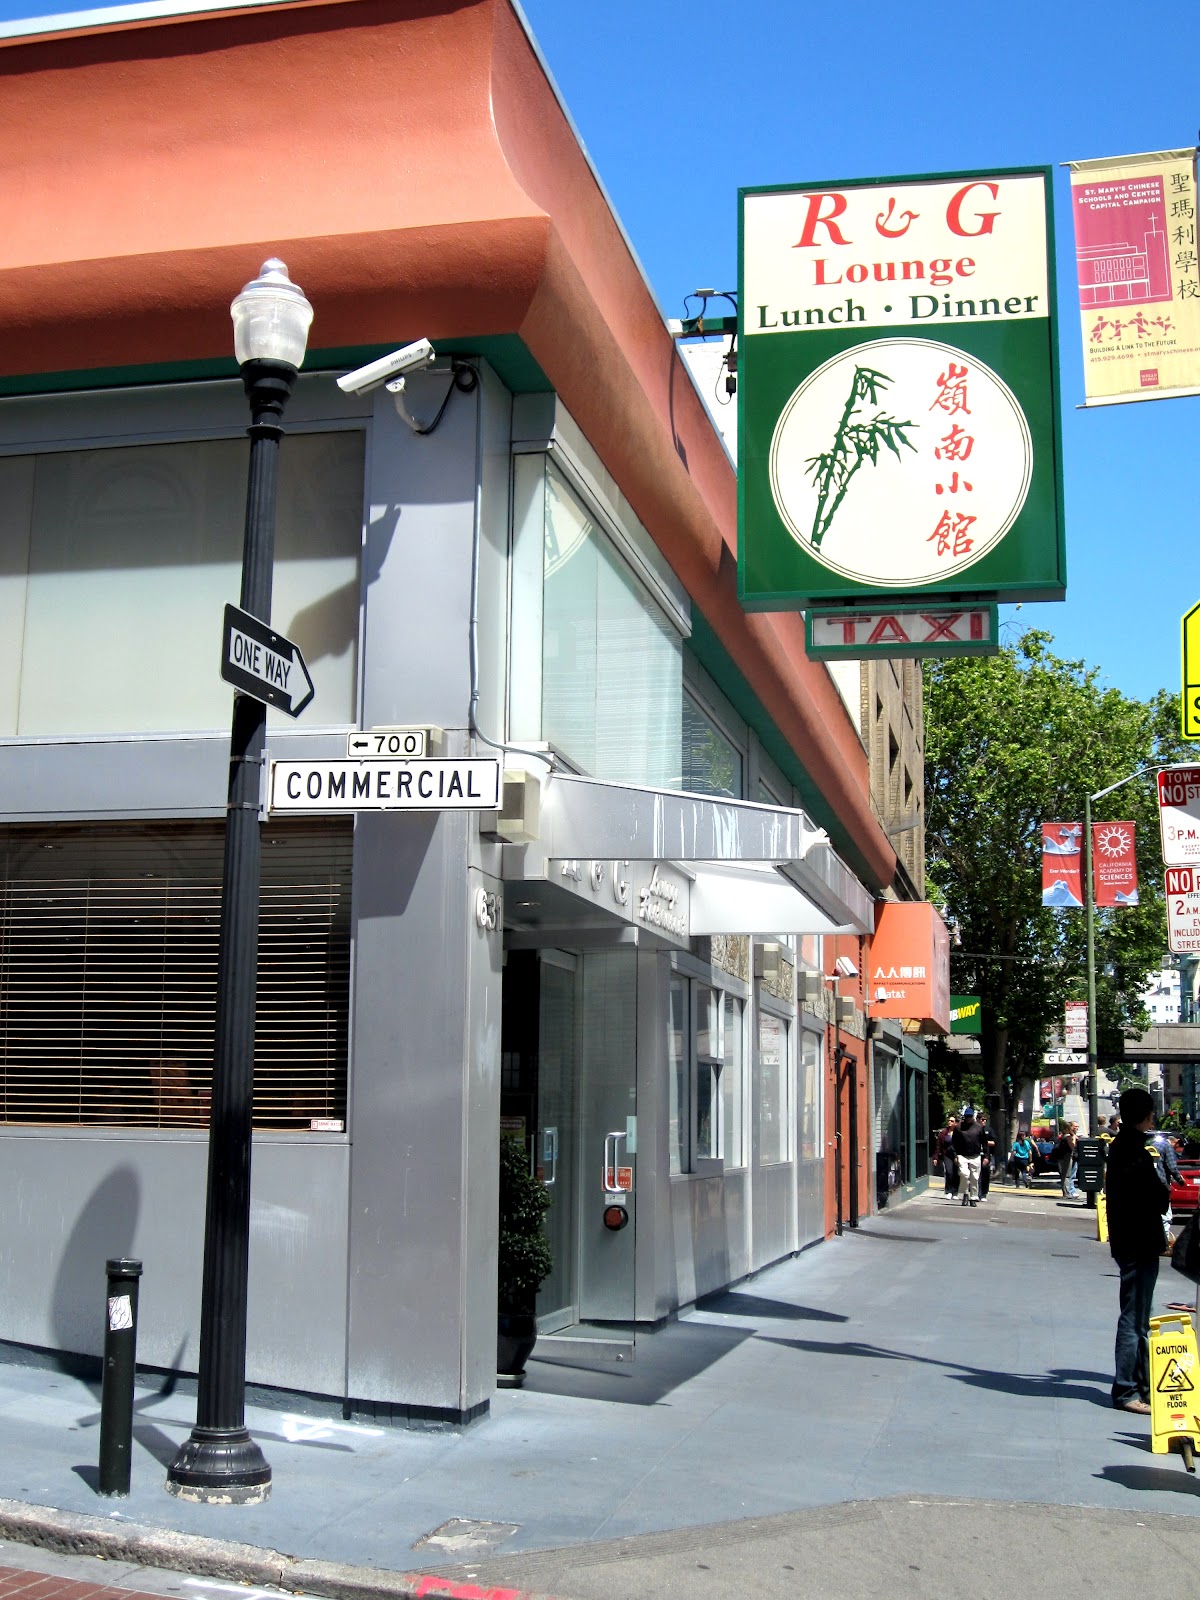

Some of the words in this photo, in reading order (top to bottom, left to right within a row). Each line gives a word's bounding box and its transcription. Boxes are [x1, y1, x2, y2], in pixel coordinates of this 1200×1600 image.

[1078, 195, 1112, 204] SCHOOLS
[1131, 190, 1160, 198] CENTER
[1098, 186, 1126, 194] MARY'S
[1128, 182, 1160, 190] CHINESE
[1090, 202, 1121, 210] CAPITAL
[1123, 197, 1161, 206] CAMPAIGN
[791, 193, 853, 248] R
[875, 197, 920, 238] &
[946, 182, 1002, 237] G
[1170, 173, 1200, 300] 聖瑪利學校
[811, 257, 976, 286] Lounge
[757, 298, 867, 328] Lunch
[909, 293, 1039, 319] Dinner
[1089, 346, 1115, 354] BUILDING
[1156, 339, 1177, 347] FUTURE
[390, 353, 412, 366] PHILIPS
[926, 363, 977, 556] 嶺南小館
[827, 612, 983, 645] TAXI
[234, 634, 261, 674] ONE
[265, 651, 291, 689] WAY
[374, 736, 417, 753] 700
[287, 770, 481, 799] COMMERCIAL
[1161, 784, 1184, 803] NO
[1168, 870, 1191, 892] NO
[476, 888, 503, 932] 631
[886, 989, 906, 999] at&t
[1156, 1345, 1188, 1355] CAUTION
